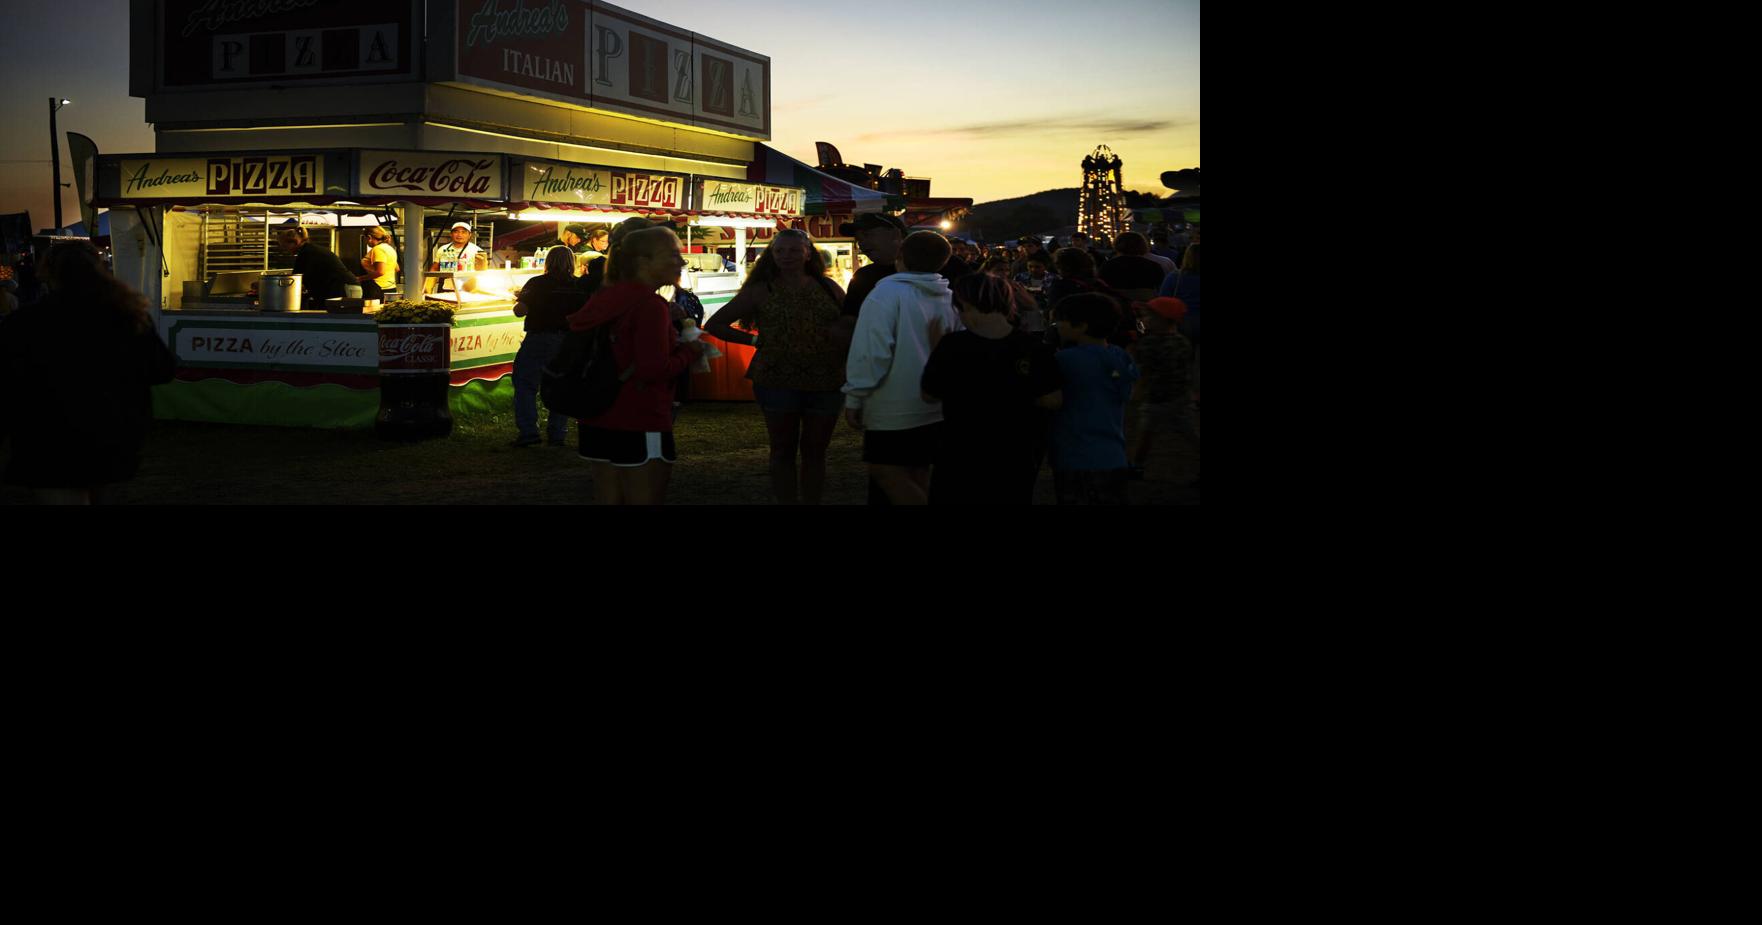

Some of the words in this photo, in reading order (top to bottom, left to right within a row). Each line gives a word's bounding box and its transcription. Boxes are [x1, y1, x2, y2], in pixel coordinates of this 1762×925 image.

[219, 30, 392, 71] PIZA
[502, 48, 575, 86] ITALIAN
[594, 23, 760, 119] PIZZA
[126, 162, 205, 194] Andrea's
[207, 158, 315, 193] PIZZA
[368, 159, 495, 194] Coca-Cola
[532, 167, 606, 197] Andrea's
[611, 173, 678, 207] PIZZA
[708, 183, 752, 204] Andrea's
[755, 187, 798, 213] PIZZA
[192, 336, 253, 353] PIZZA
[259, 338, 282, 359] by
[285, 339, 314, 356] the
[318, 339, 366, 358] Slice
